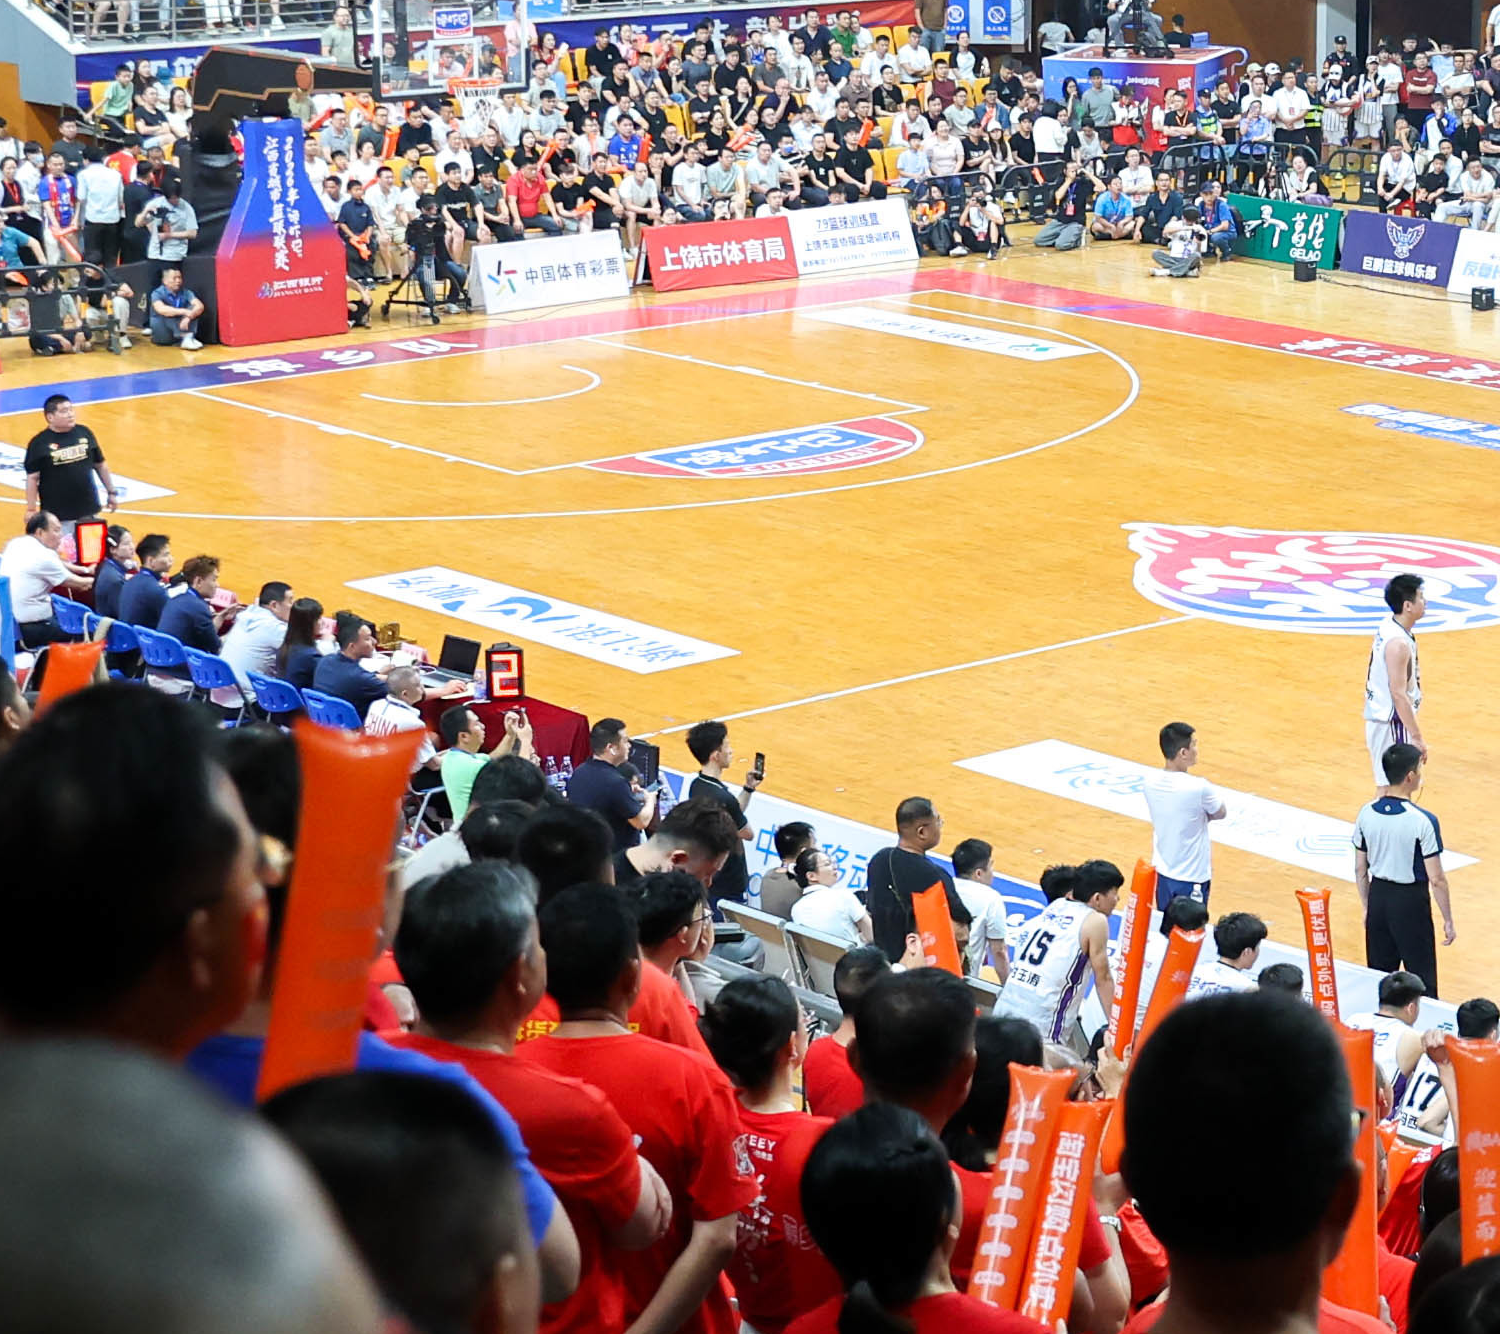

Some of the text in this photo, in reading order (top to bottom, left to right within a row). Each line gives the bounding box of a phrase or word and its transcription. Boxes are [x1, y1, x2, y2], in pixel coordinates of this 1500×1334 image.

[525, 254, 621, 285] 中国体育彩票
[659, 237, 786, 273] 上饶市体育局
[1289, 247, 1321, 262] GELAO
[1362, 255, 1438, 281] 巨鹏篮球俱乐部
[492, 653, 519, 697] 2
[754, 821, 870, 891] 中移动
[1019, 926, 1055, 967] 15
[1407, 1072, 1443, 1111] 17
